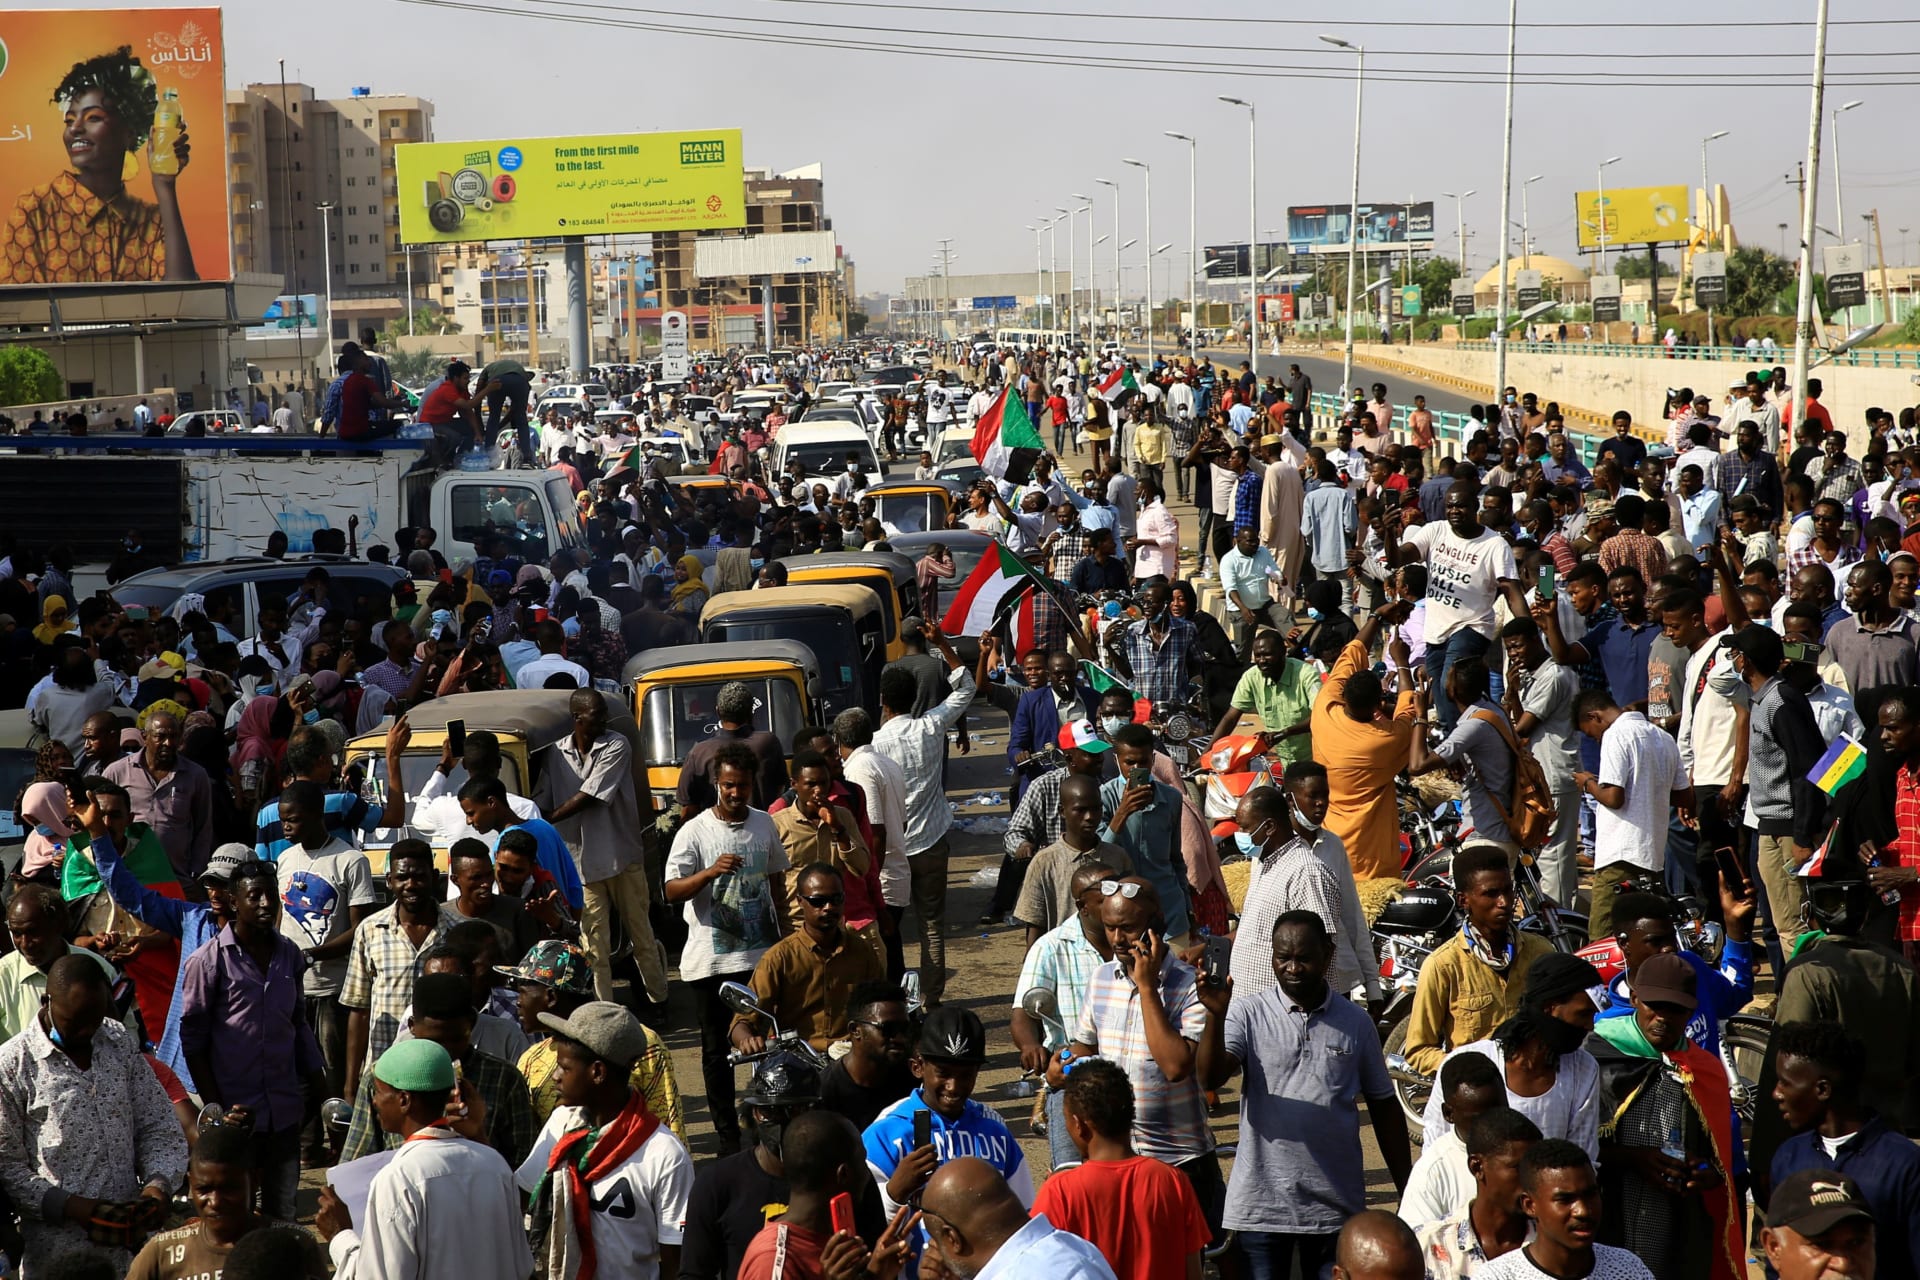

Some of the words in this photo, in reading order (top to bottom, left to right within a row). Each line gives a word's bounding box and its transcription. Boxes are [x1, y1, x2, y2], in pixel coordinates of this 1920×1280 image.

[150, 42, 212, 65] أناناس
[555, 147, 578, 158] From
[580, 147, 595, 157] the
[597, 146, 616, 156] first
[618, 145, 639, 155] mile
[682, 143, 722, 153] MANN
[682, 152, 723, 162] FILTER
[555, 162, 565, 171] to
[567, 161, 582, 171] the
[584, 160, 604, 170] last.
[1429, 562, 1471, 584] MUSIC
[1427, 587, 1462, 609] OUSE
[893, 1130, 1007, 1163] LNDON
[1810, 1191, 1845, 1206] PUMA
[165, 1244, 186, 1265] 19
